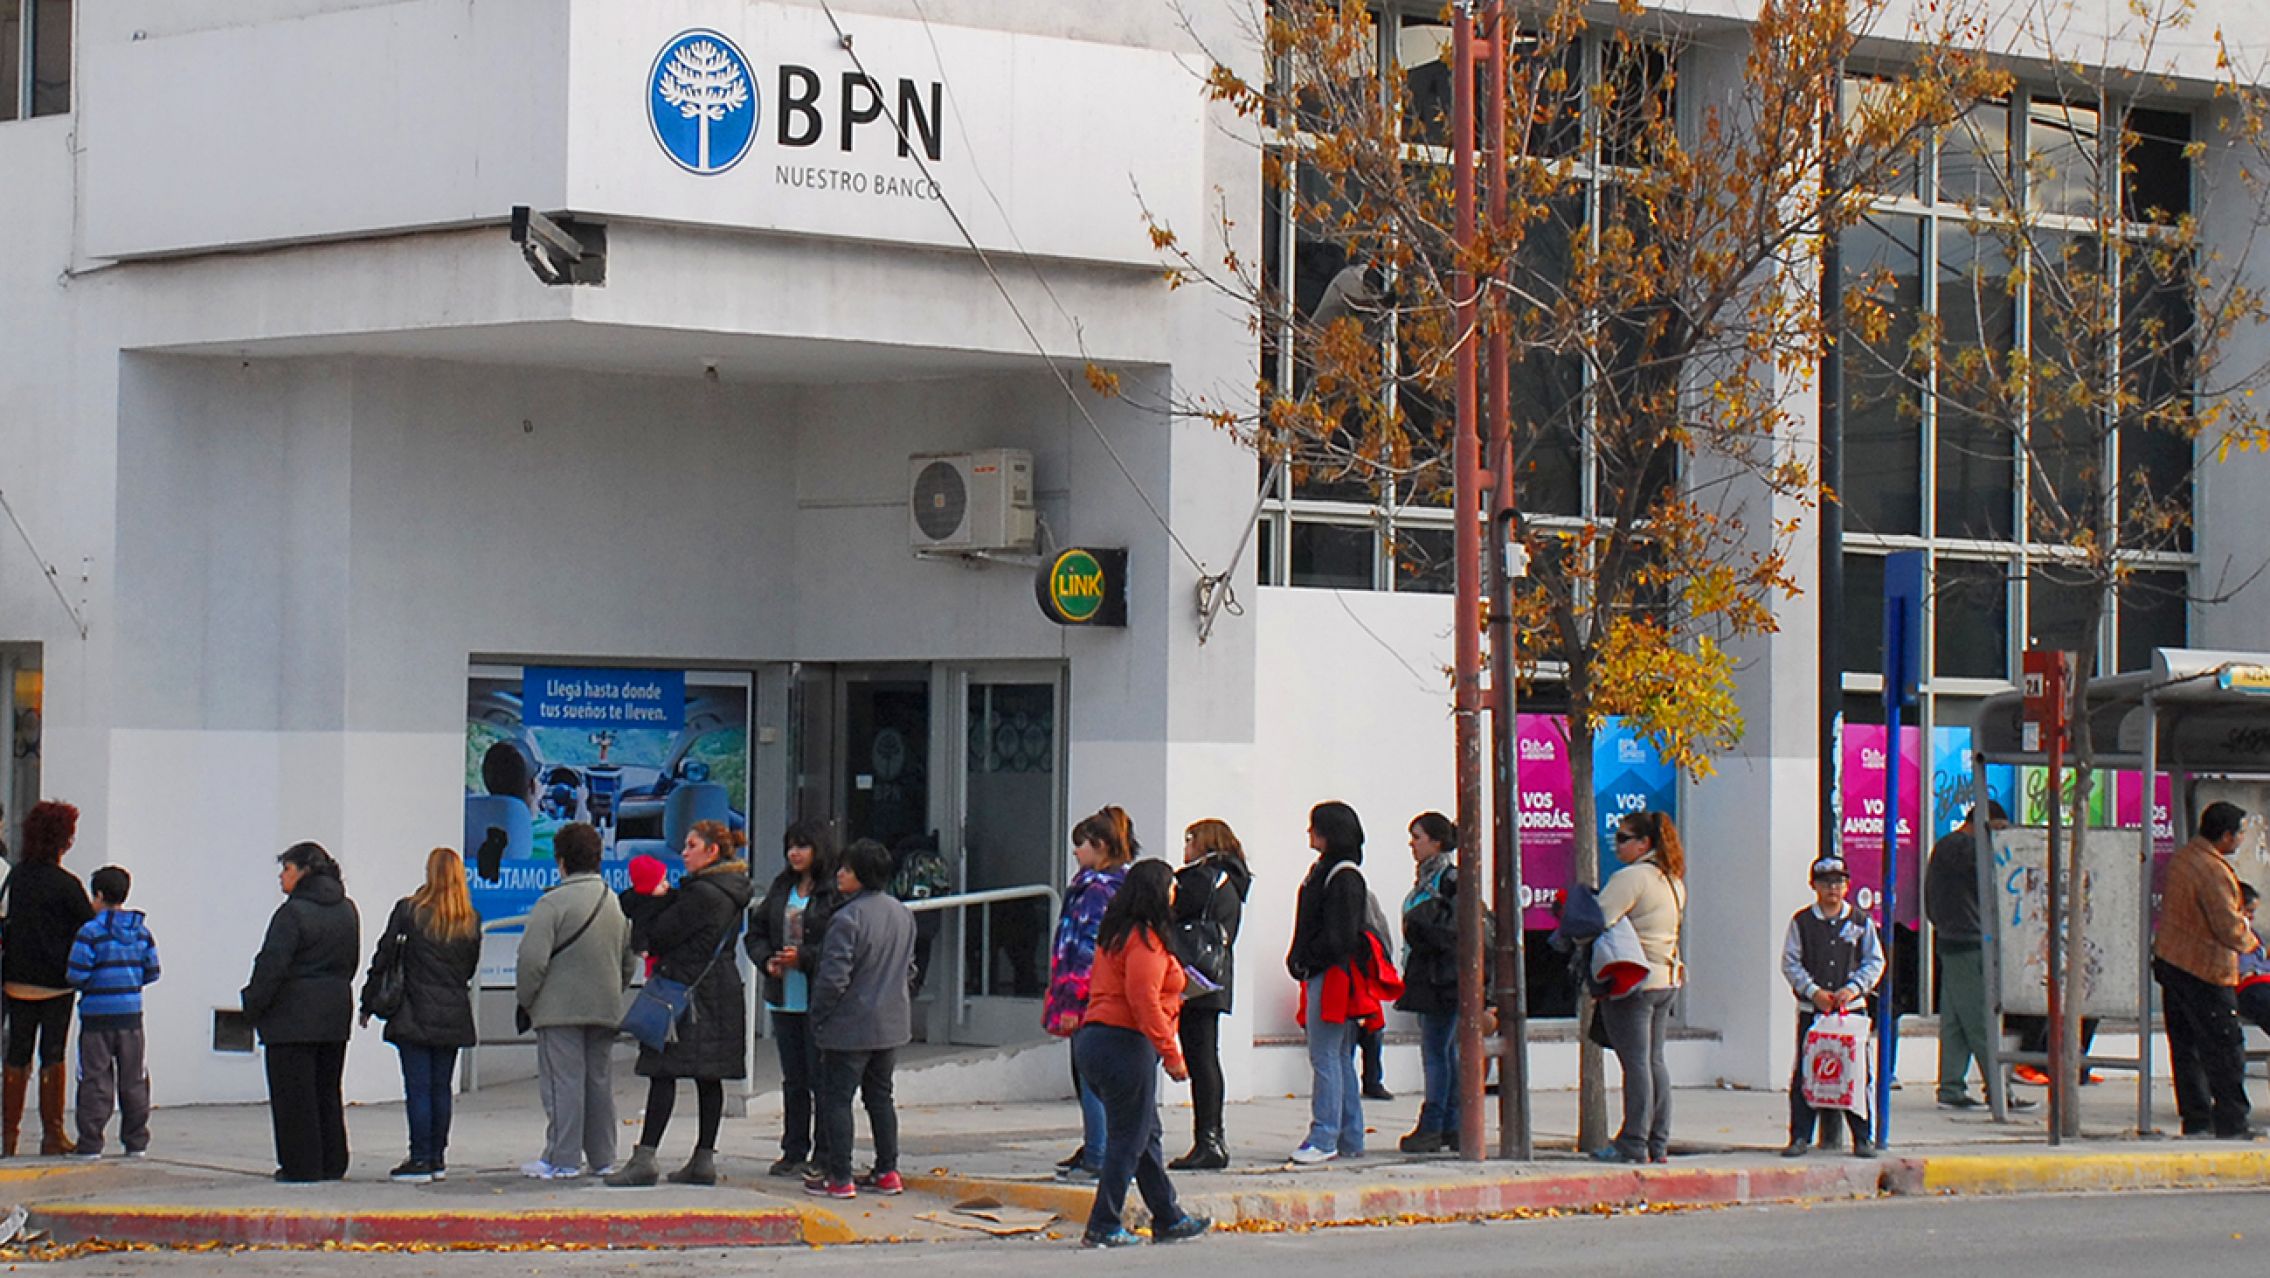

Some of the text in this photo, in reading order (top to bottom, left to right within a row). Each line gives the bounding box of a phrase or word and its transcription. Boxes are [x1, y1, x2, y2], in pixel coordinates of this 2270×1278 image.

[777, 65, 943, 162] BPN
[776, 165, 942, 200] NUESTRO BANCO
[547, 679, 662, 701] Llegá hasta donde
[540, 702, 667, 722] tus sueños te lleven.
[1522, 791, 1553, 808] VOS
[1616, 793, 1646, 811] VOS
[1863, 799, 1885, 815] VO
